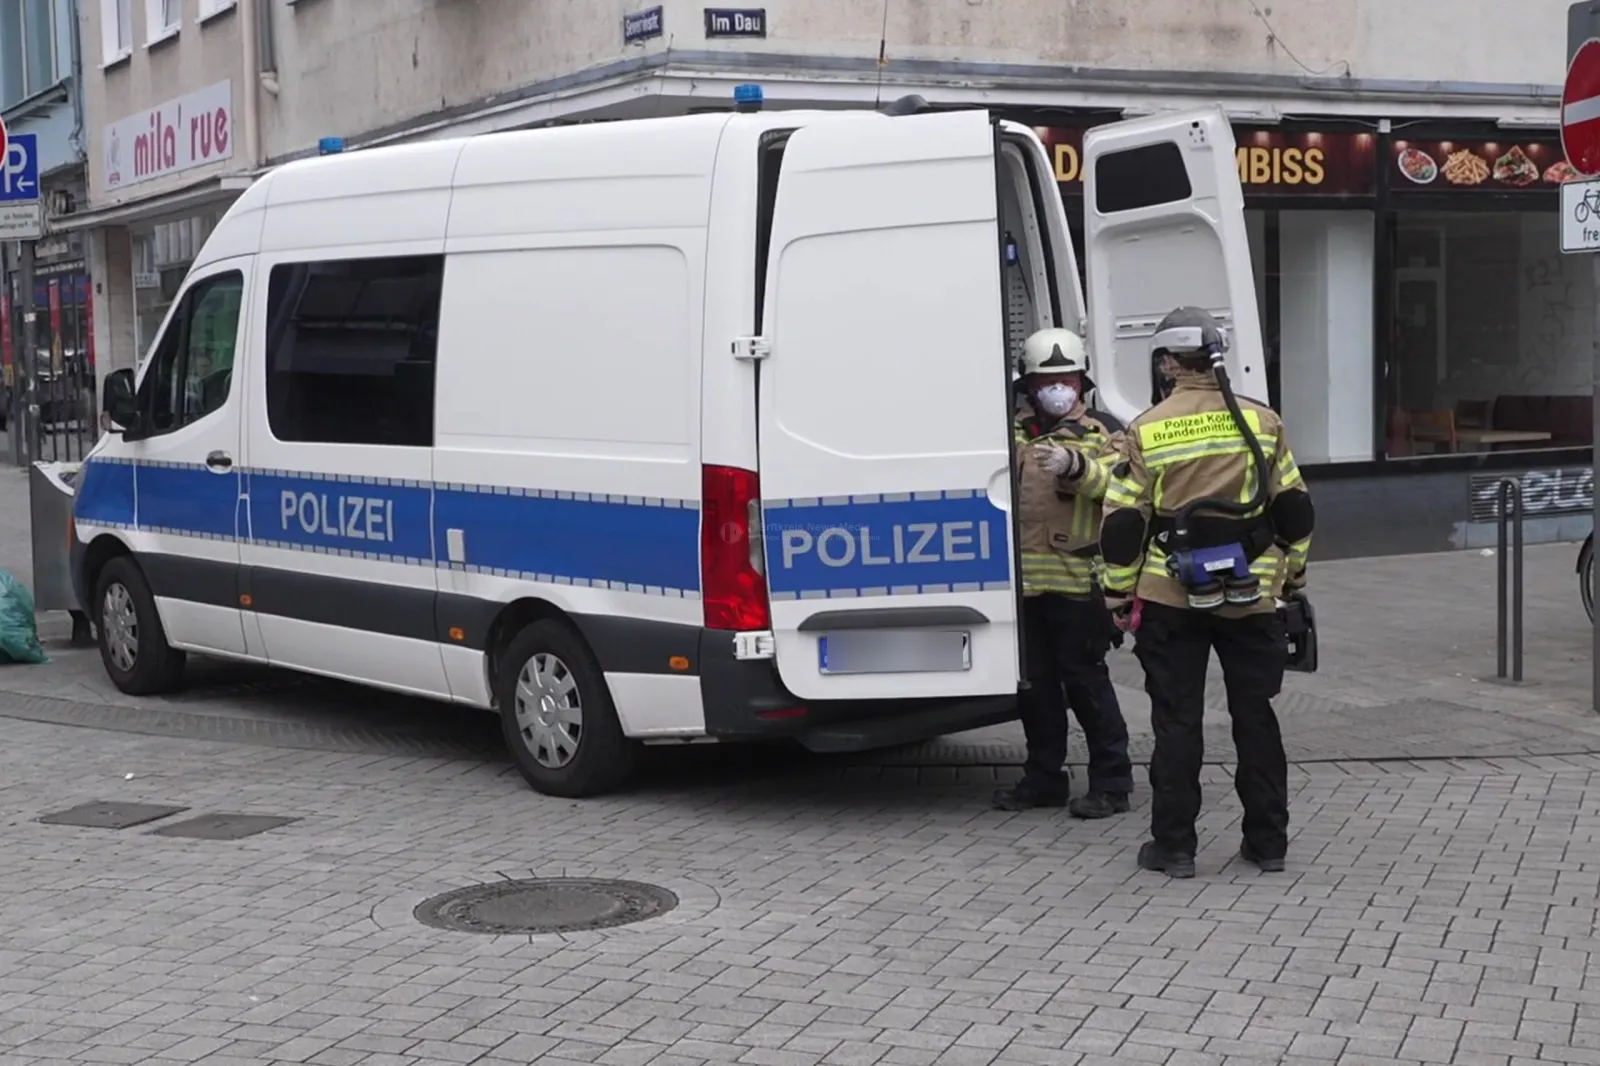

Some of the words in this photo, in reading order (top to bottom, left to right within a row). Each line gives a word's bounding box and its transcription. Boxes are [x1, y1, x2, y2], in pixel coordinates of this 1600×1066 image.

[712, 13, 730, 31] Im
[734, 13, 761, 31] Dau
[191, 107, 228, 161] rue
[1164, 417, 1204, 430] Polizei
[281, 490, 394, 542] POLIZEI
[781, 520, 990, 569] POLIZEI
